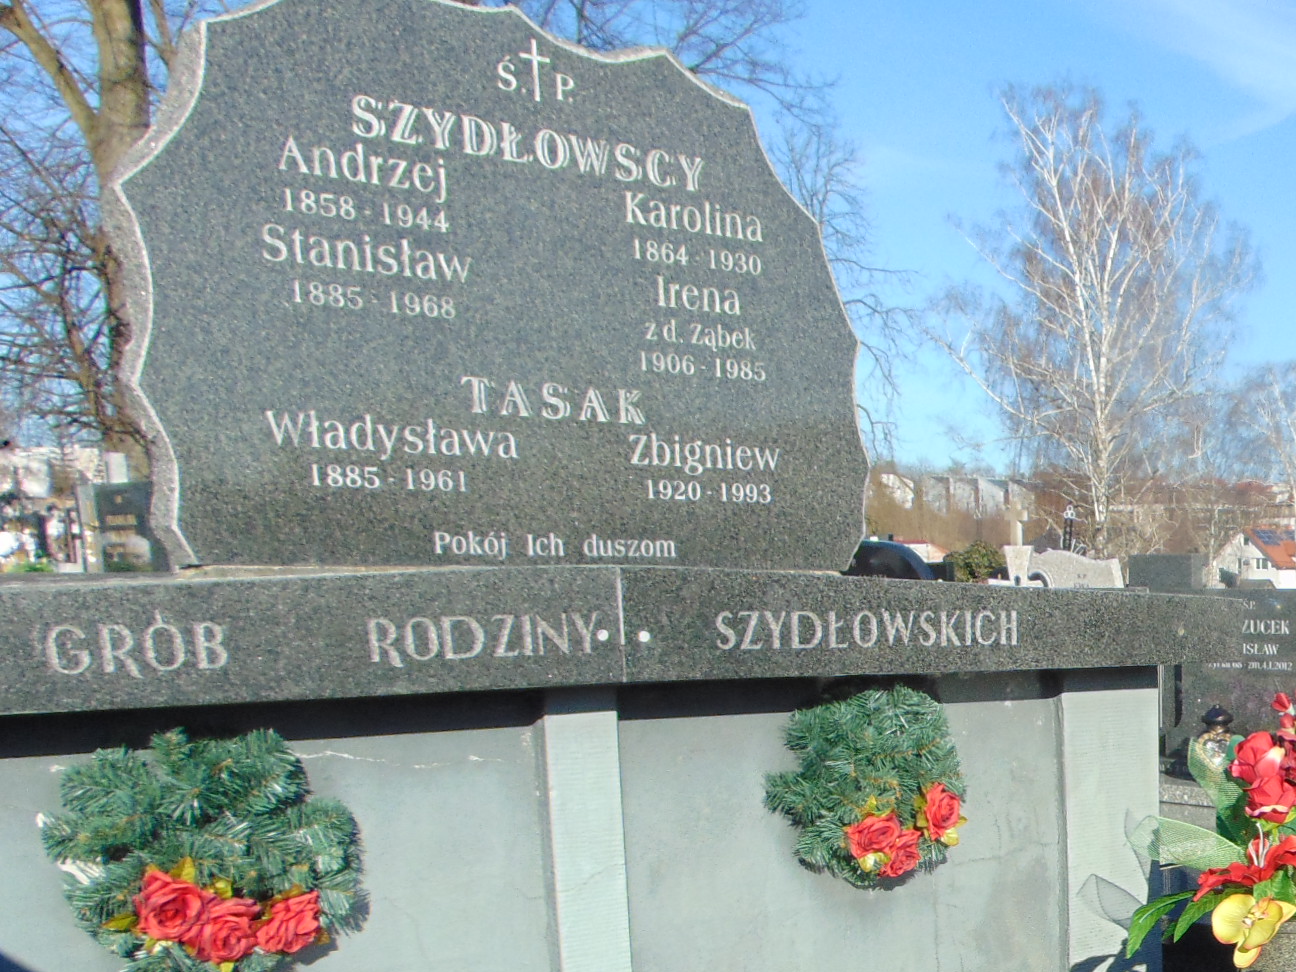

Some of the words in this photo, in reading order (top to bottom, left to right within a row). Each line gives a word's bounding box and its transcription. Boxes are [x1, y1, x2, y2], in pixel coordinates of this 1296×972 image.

[278, 134, 447, 203] Andrzej
[351, 94, 704, 192] SZYDŁOWSCY
[624, 190, 763, 242] Karolina
[261, 222, 472, 283] Stanisław
[656, 275, 741, 316] Irena
[690, 323, 757, 355] Ząbek
[461, 376, 647, 426] TASAK
[265, 409, 519, 462] Władysława
[628, 434, 780, 476] Zbigniew
[433, 531, 508, 560] Pokój
[526, 534, 565, 556] Ich
[583, 534, 677, 559] duszom
[45, 608, 229, 679] GRÓB
[716, 608, 1019, 652] SZYDŁOWSKICH
